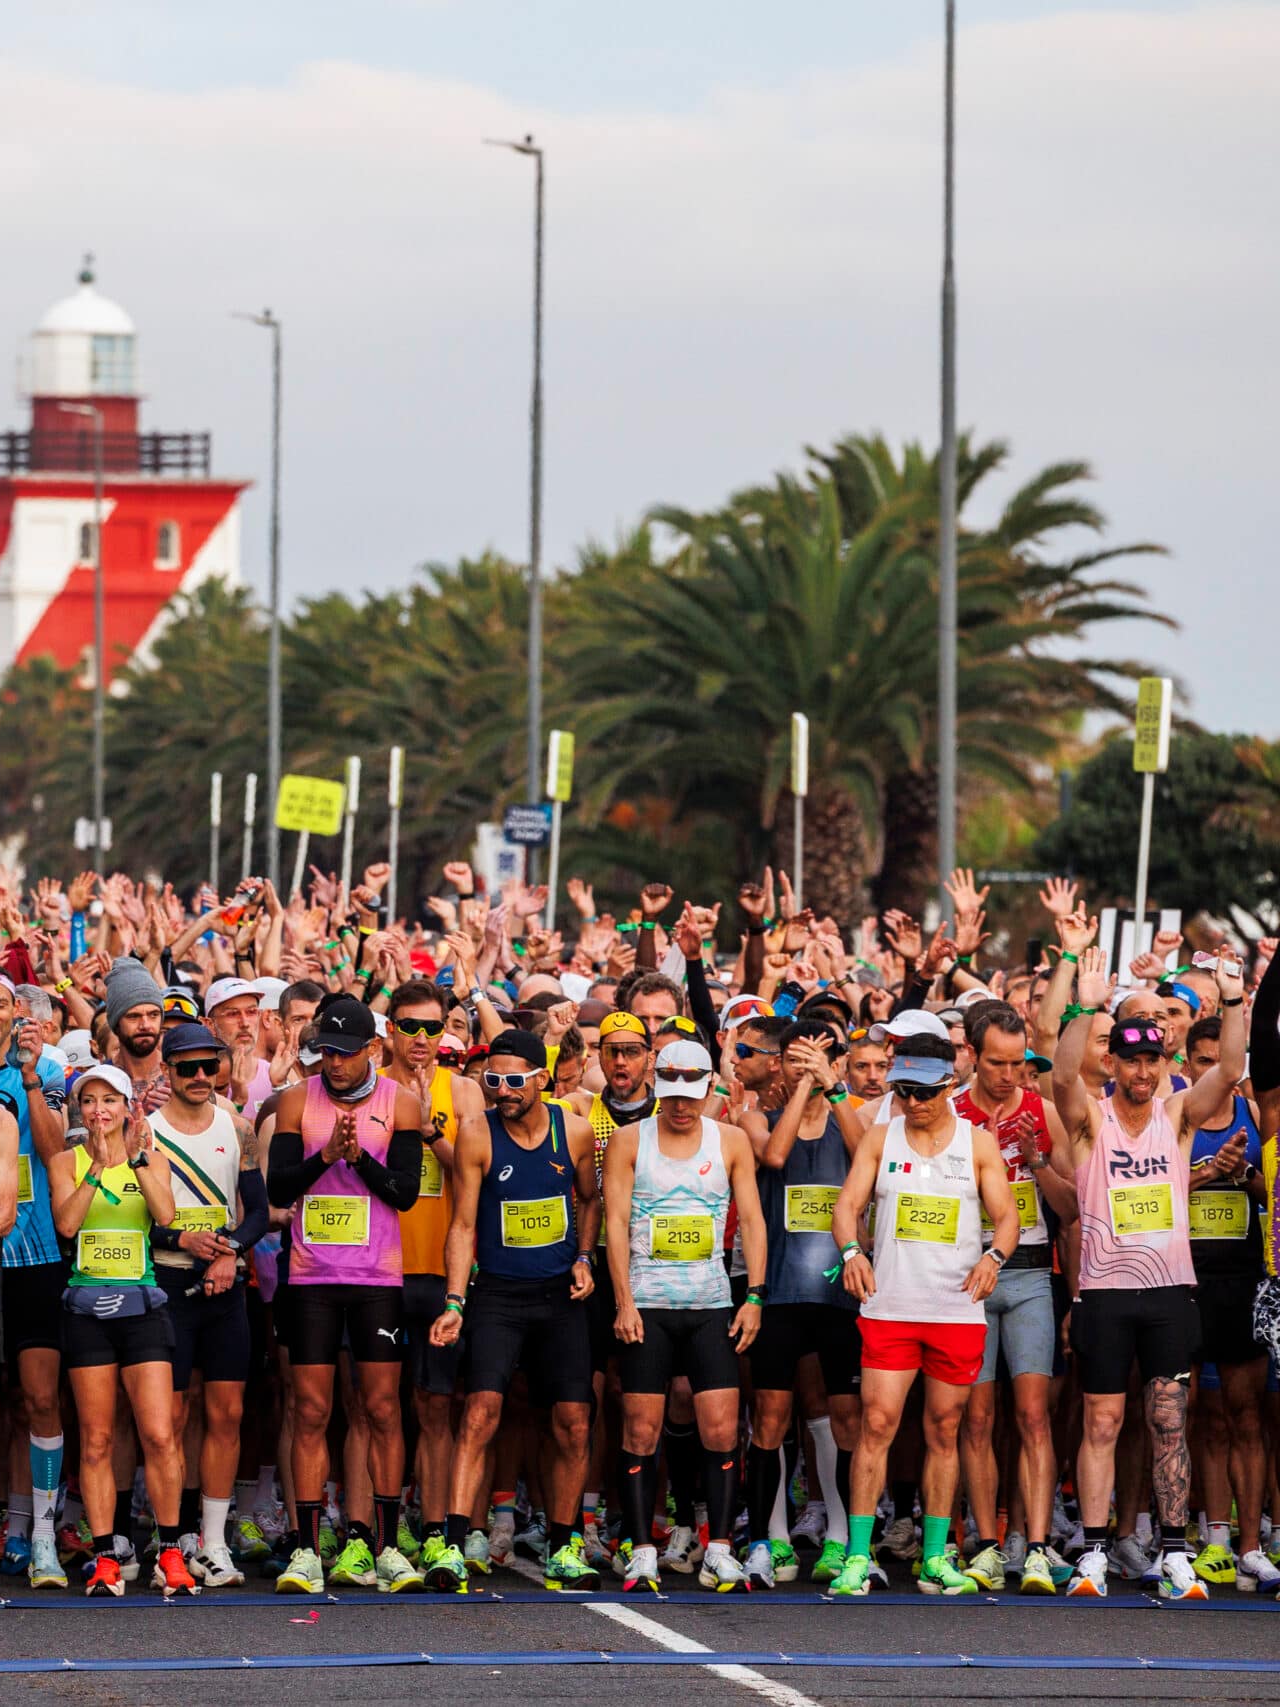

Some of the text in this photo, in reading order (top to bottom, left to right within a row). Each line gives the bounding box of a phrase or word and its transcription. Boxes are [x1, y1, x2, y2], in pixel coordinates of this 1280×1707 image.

[1130, 1201, 1159, 1215] 1313
[1201, 1208, 1234, 1220] 1878
[320, 1213, 352, 1225] 1877
[520, 1215, 551, 1230] 1013
[910, 1210, 946, 1225] 2322
[668, 1231, 700, 1244] 2133
[93, 1247, 131, 1260] 2689
